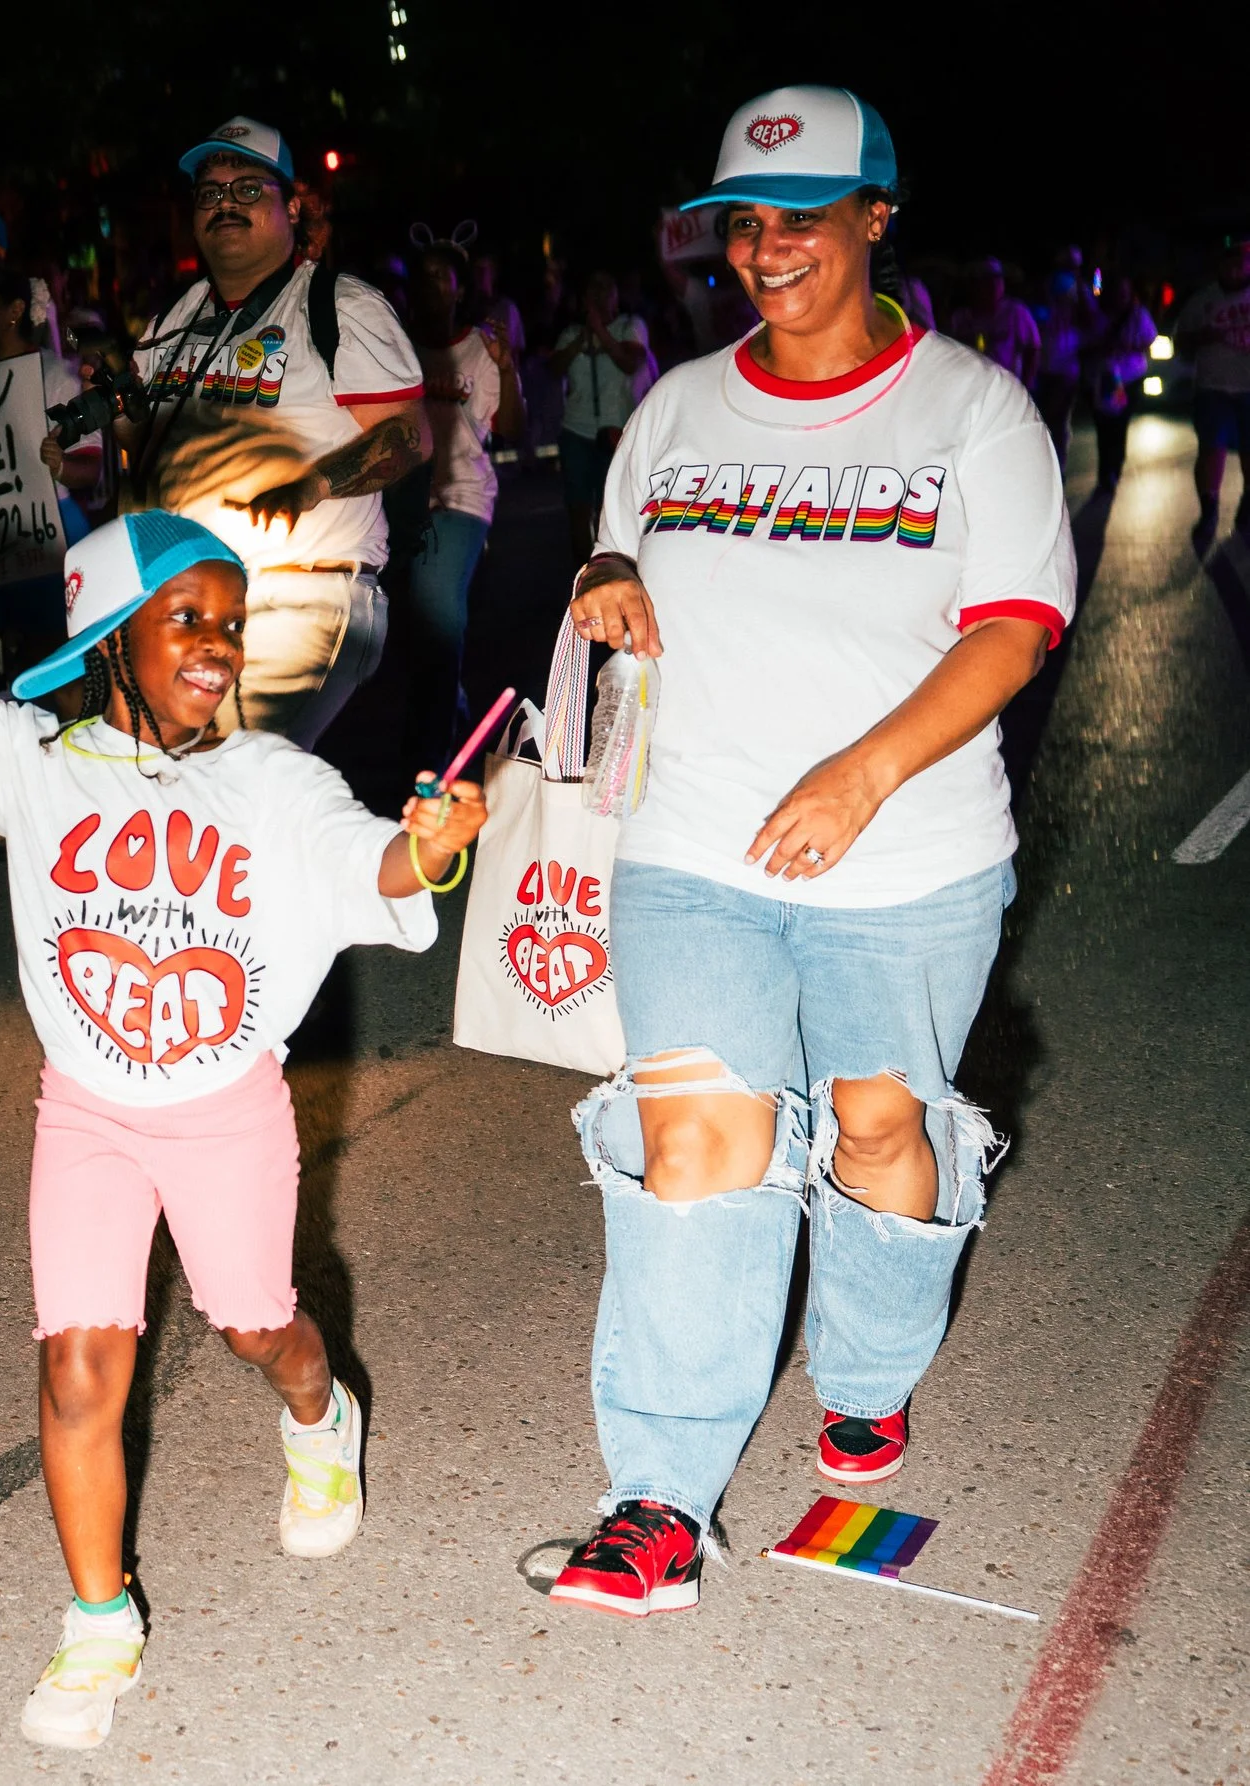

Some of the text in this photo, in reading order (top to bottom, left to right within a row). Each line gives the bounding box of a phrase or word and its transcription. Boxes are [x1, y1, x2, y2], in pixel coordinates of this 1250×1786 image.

[753, 122, 793, 145] BEAT
[768, 464, 947, 549] AIDS
[50, 809, 251, 918] LOVE
[117, 897, 195, 930] with
[515, 937, 595, 1001] BEAT
[67, 950, 230, 1063] BEAT
